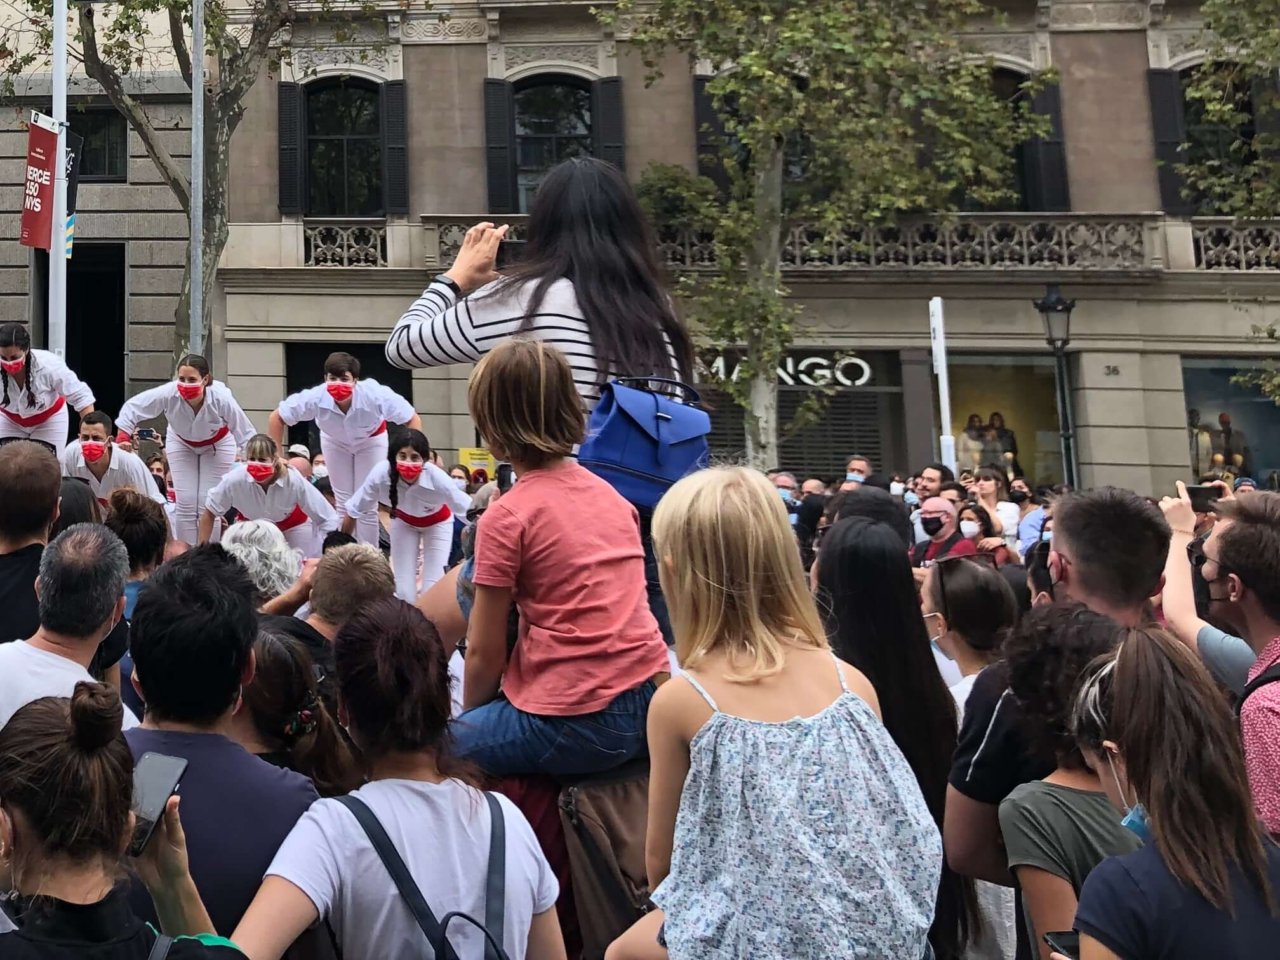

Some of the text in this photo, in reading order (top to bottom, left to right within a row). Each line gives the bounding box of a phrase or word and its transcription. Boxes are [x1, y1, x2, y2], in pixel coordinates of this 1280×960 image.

[26, 181, 39, 197] 150
[693, 356, 872, 387] MNGO
[1104, 365, 1120, 377] 36
